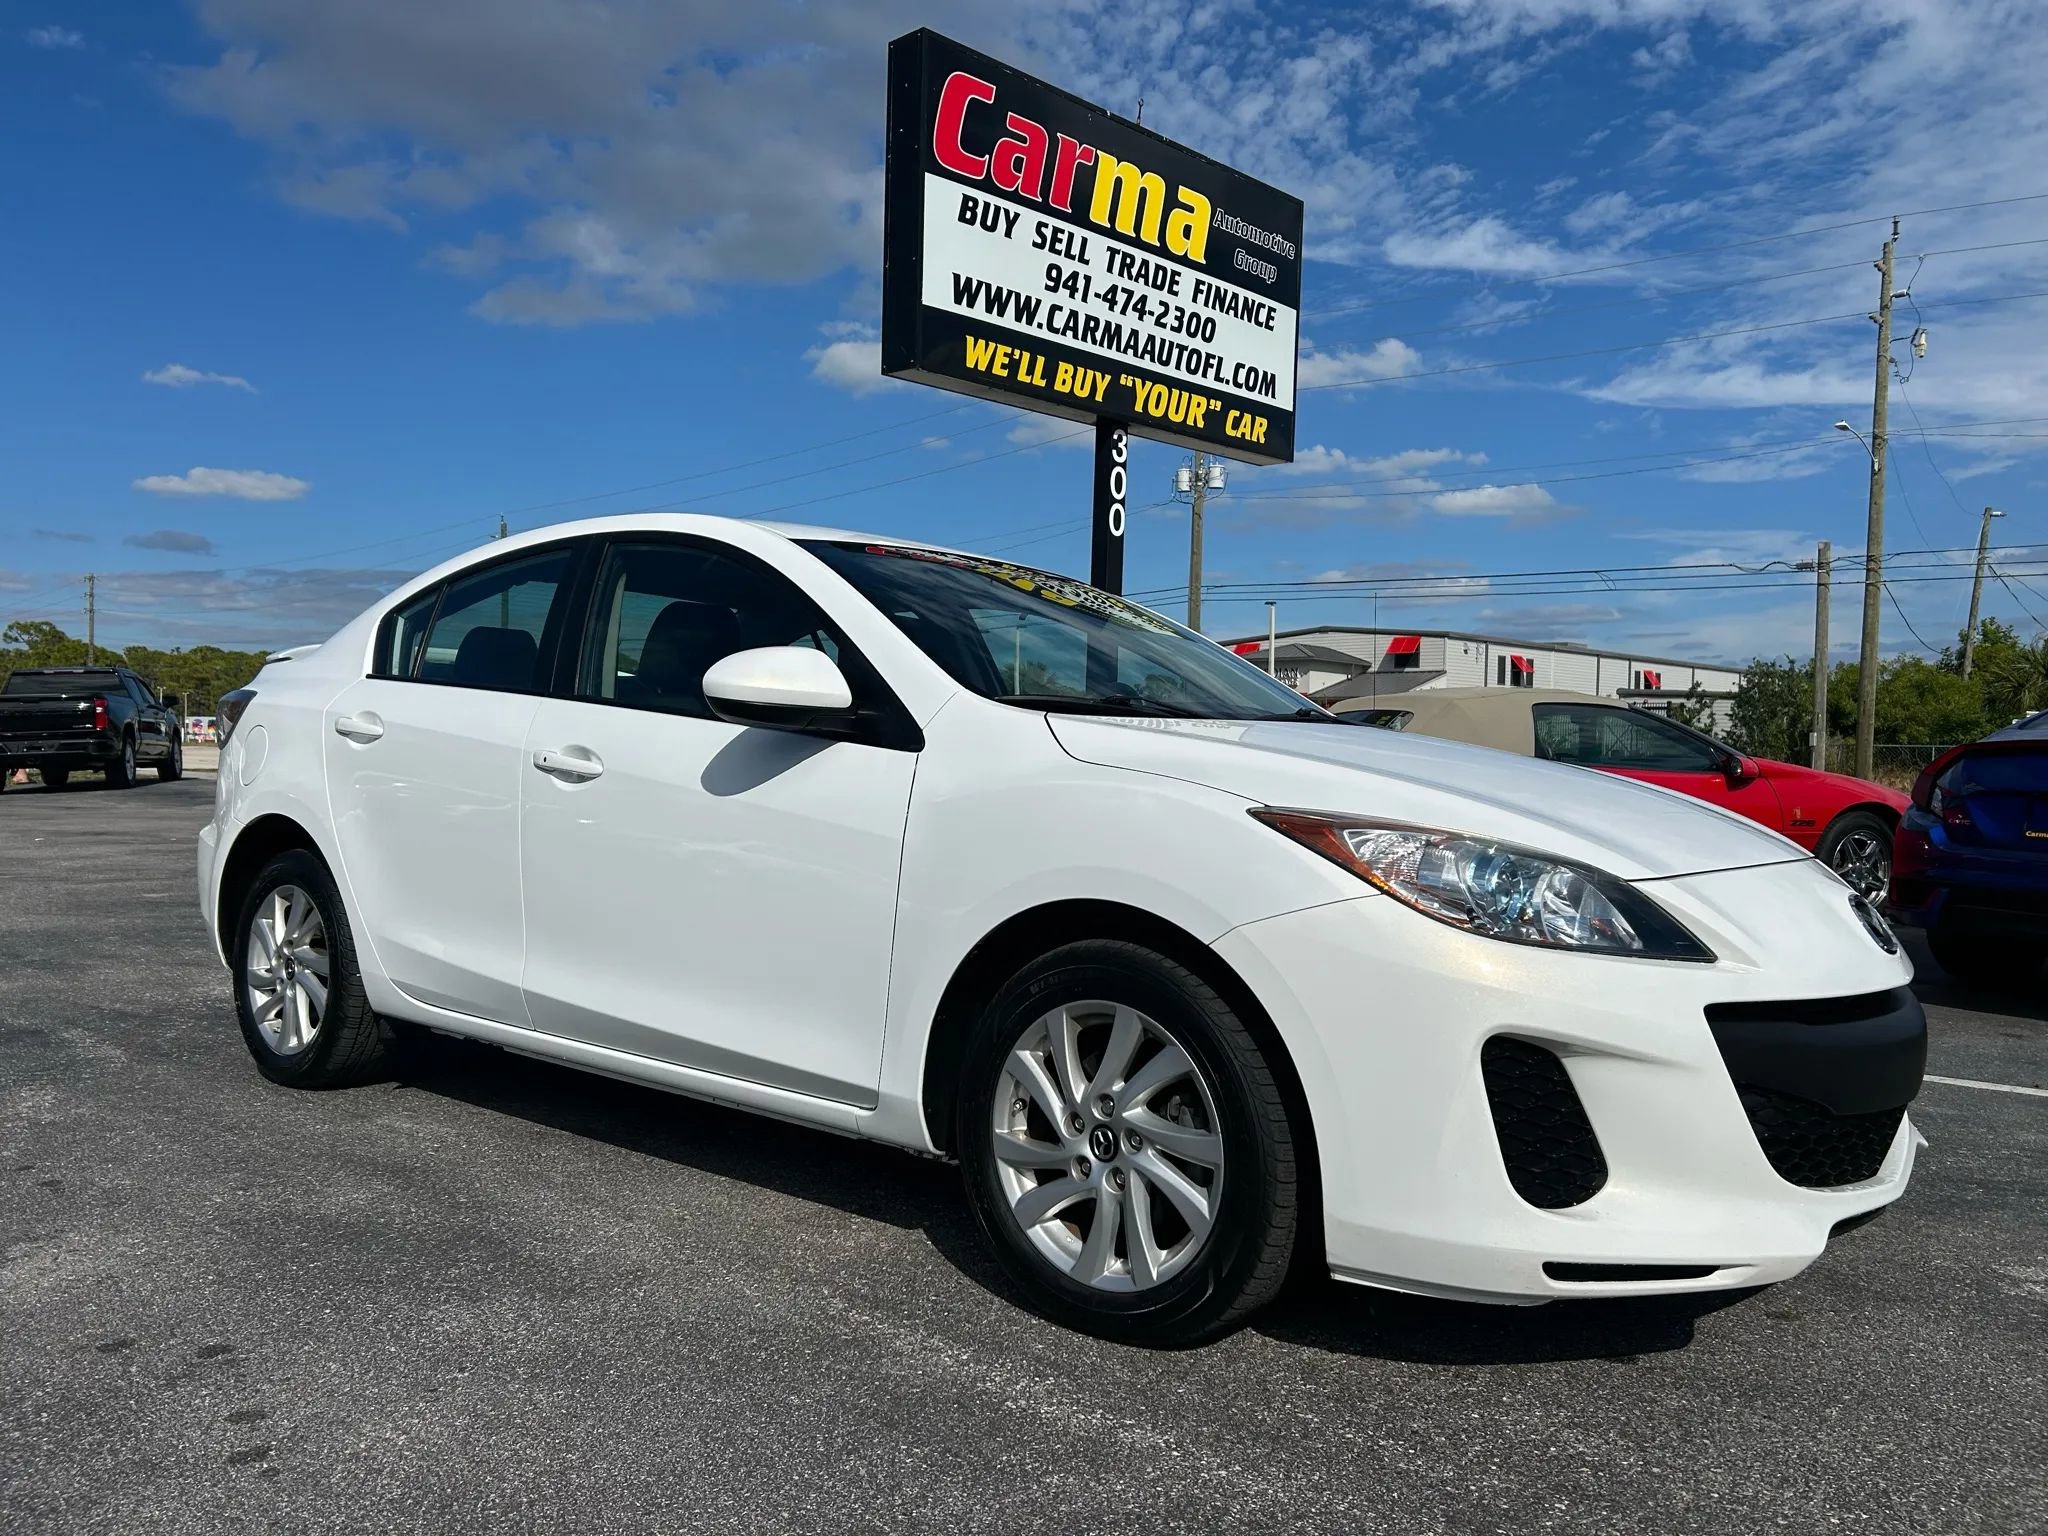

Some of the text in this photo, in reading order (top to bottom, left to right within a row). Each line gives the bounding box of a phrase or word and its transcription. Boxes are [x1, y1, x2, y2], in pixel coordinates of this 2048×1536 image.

[933, 71, 1212, 264] Carma
[957, 192, 1277, 332] BUY SELL TRADE FINANCE
[1213, 207, 1296, 259] Automotive
[1234, 248, 1277, 284] Group
[952, 272, 1276, 399] WWW.CARMAAUTOFL.COM
[1044, 263, 1217, 344] 941-474-2300
[965, 335, 1268, 444] WE'LL BUY "YOUR" CAR
[1108, 428, 1128, 537] 300
